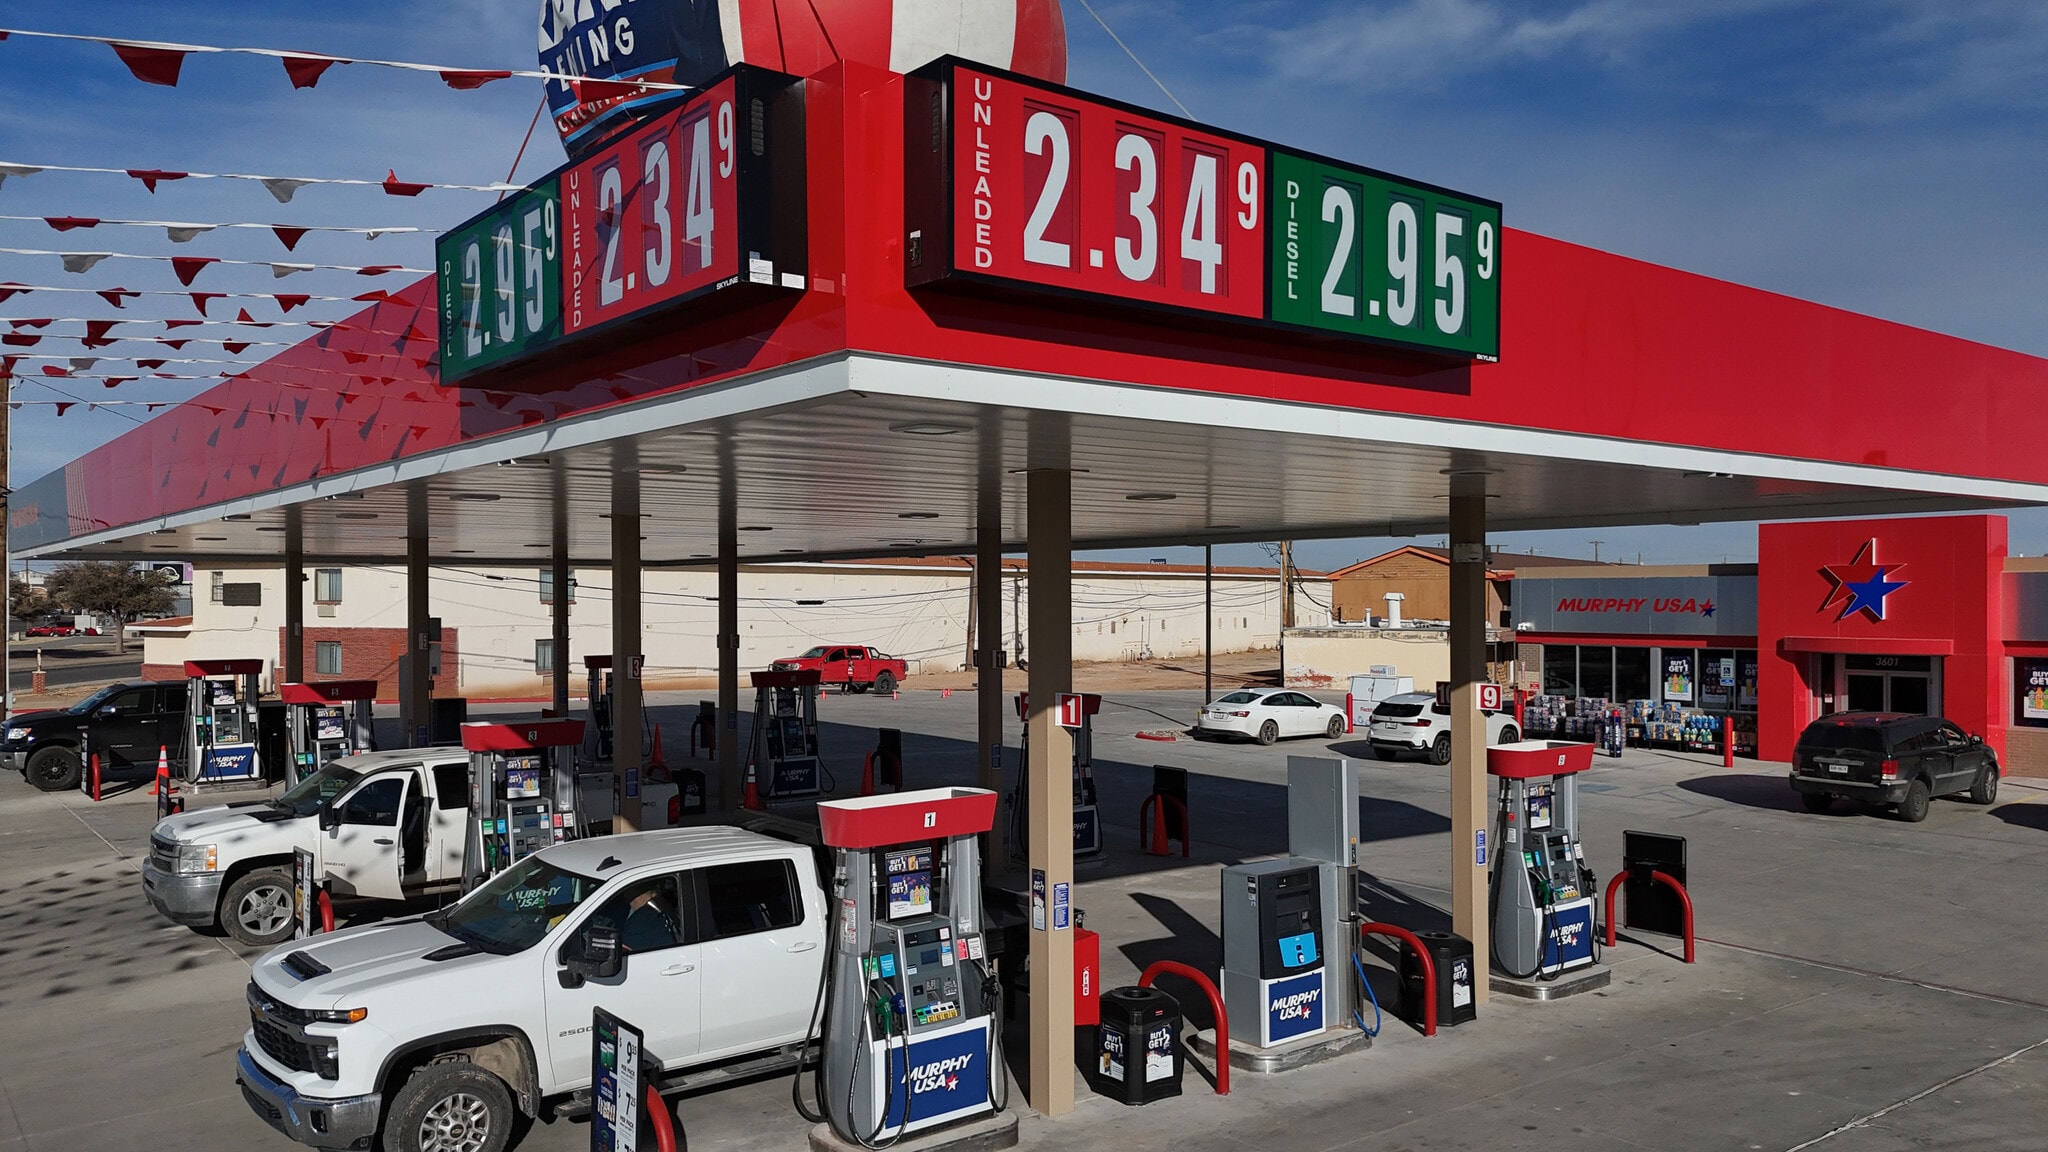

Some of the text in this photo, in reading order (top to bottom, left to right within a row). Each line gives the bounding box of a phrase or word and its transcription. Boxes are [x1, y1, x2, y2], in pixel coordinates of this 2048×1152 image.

[973, 77, 993, 269] UNLEADED
[1286, 180, 1300, 300] DIESEL
[569, 171, 582, 328] UNLEADED
[716, 275, 739, 290] SKYLINE
[444, 260, 453, 357] DIESEL
[1556, 598, 1697, 613] MURPHY USA
[1668, 665, 1685, 673] GET
[1875, 656, 1900, 667] 3601
[1483, 686, 1498, 708] 9
[1066, 697, 1076, 724] 1
[927, 814, 932, 826] 1
[888, 863, 902, 872] GET
[891, 886, 904, 895] GET
[1270, 988, 1321, 1012] MURPHY
[1279, 1004, 1303, 1021] USA
[1106, 1034, 1119, 1044] BUY
[1148, 1037, 1164, 1049] GET
[1149, 1030, 1162, 1041] BUY
[1104, 1041, 1119, 1053] GET
[900, 1053, 973, 1084] MURPHY
[913, 1073, 946, 1094] USA
